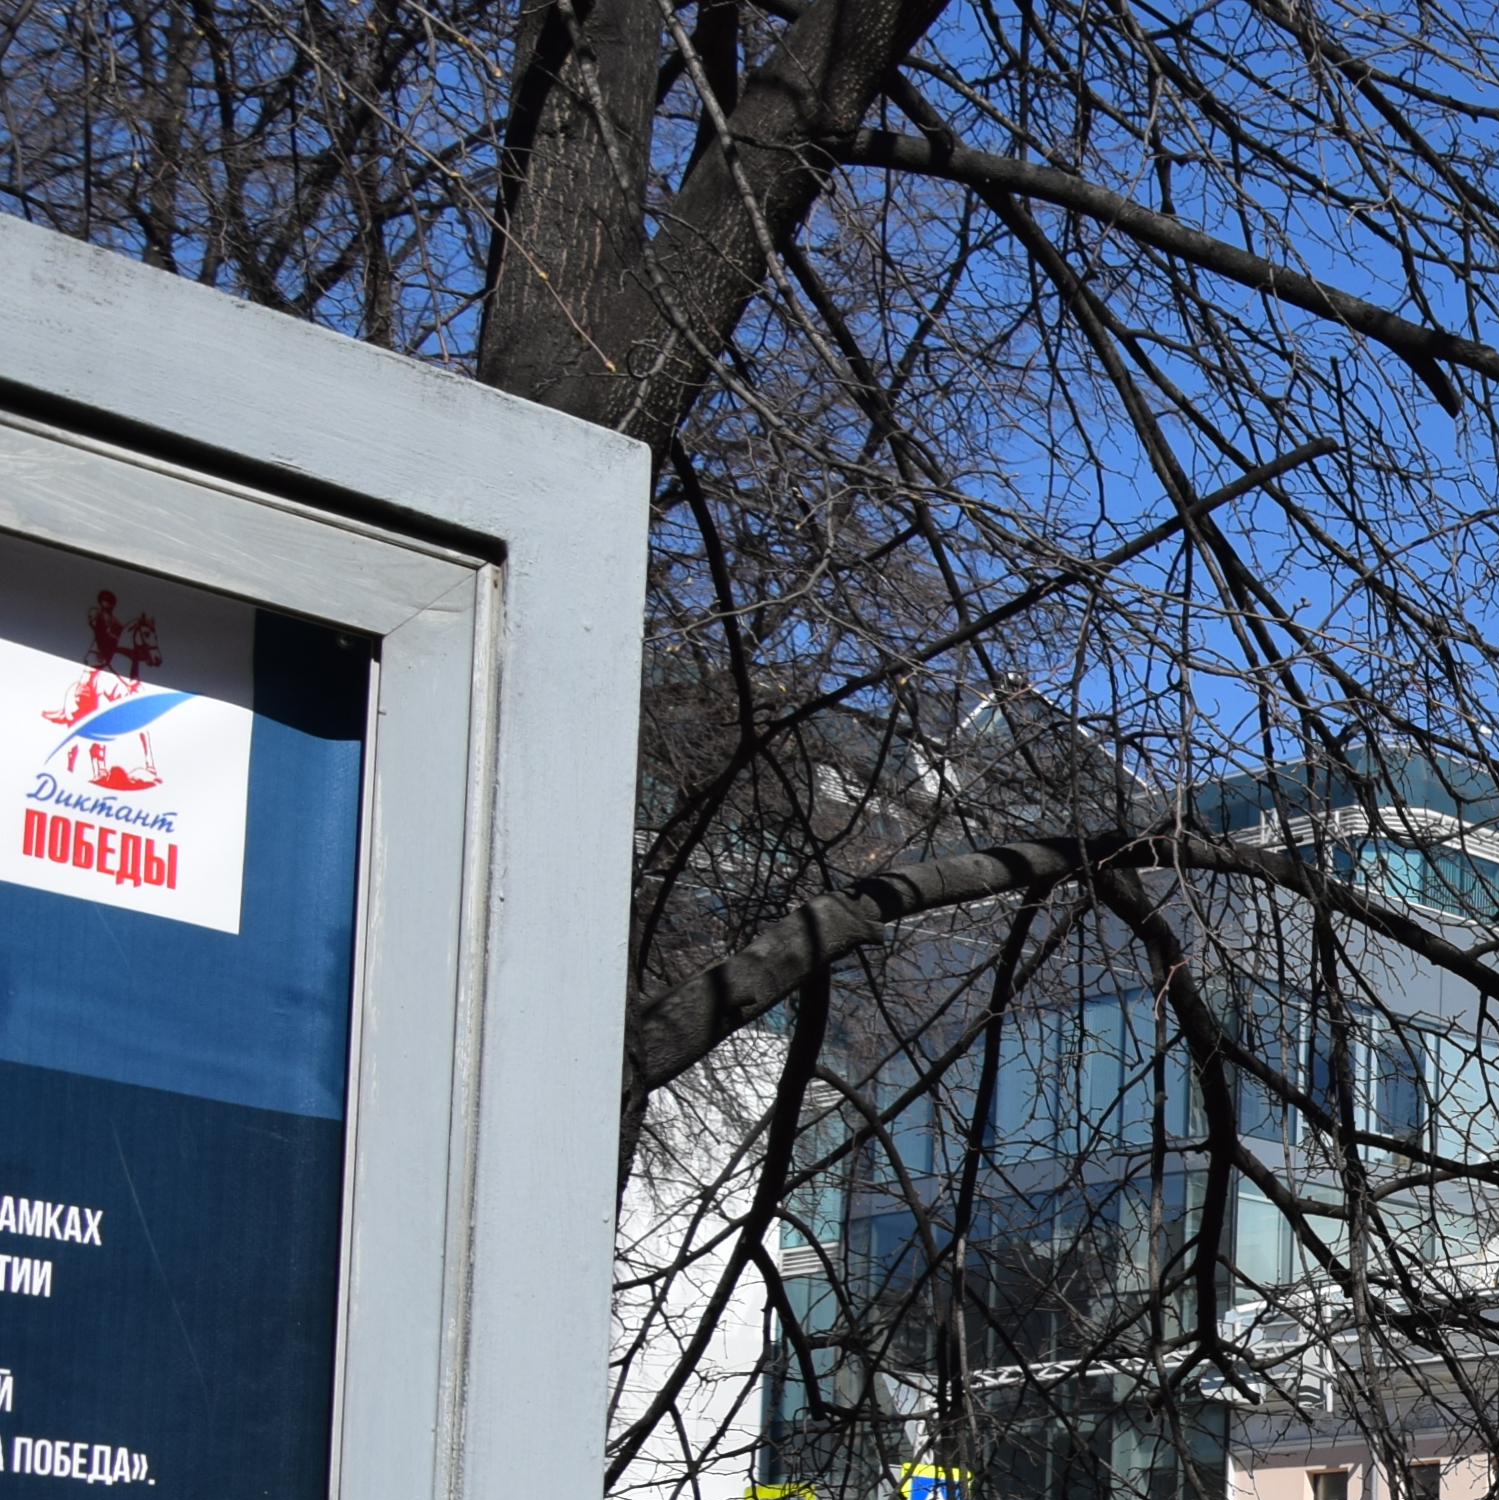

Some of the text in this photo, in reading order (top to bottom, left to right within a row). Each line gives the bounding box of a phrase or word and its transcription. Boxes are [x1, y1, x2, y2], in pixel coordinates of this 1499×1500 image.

[26, 771, 178, 833] Диктант
[22, 807, 178, 890] ПОБЕДЫ
[12, 1436, 156, 1485] ПОБЕДА».
